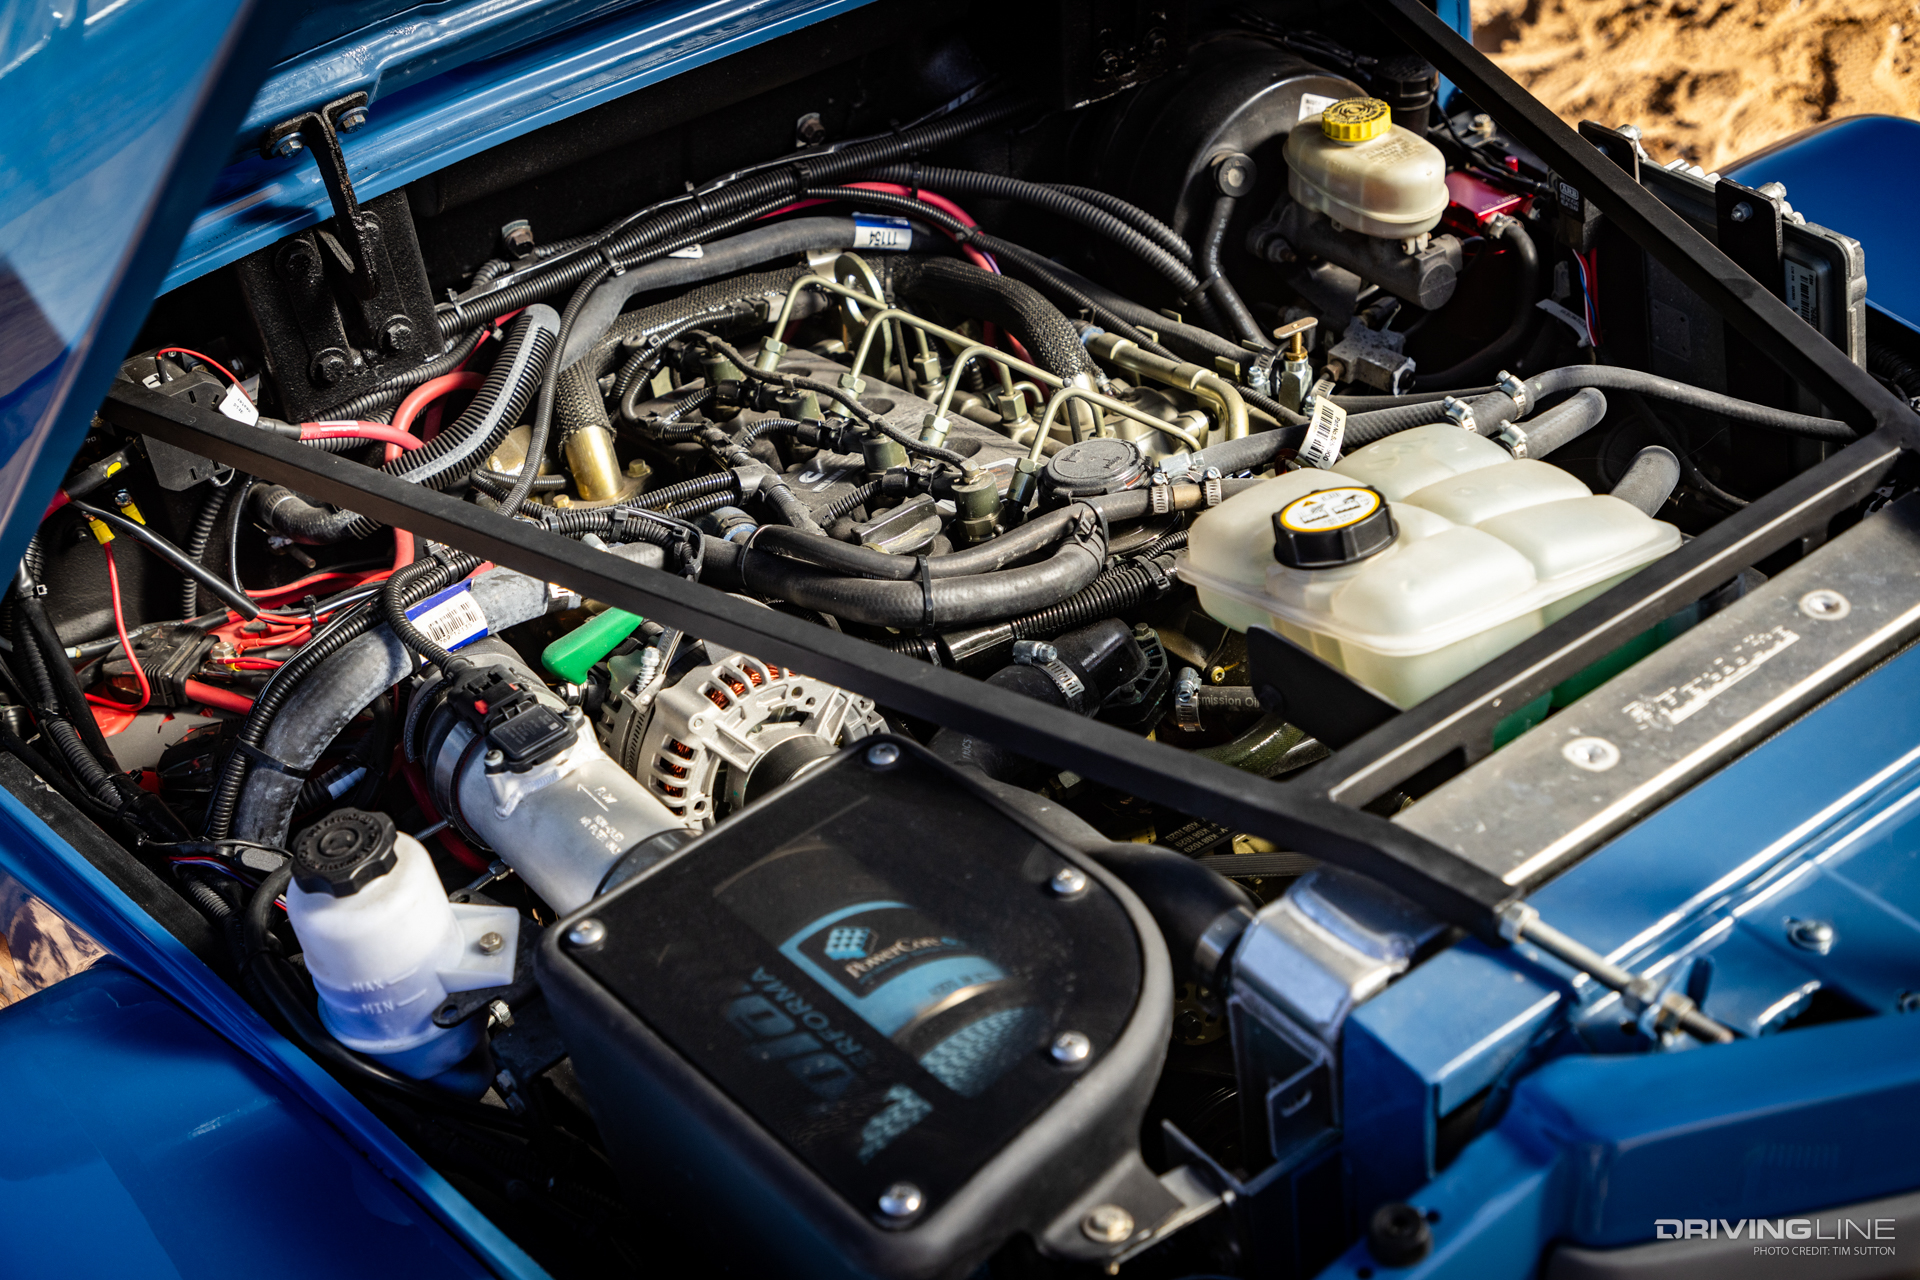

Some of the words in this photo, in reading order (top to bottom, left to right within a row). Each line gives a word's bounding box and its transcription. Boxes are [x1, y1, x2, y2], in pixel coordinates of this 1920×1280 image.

[869, 231, 897, 246] 11154
[352, 979, 384, 993] MAX
[361, 1000, 394, 1015] MIN
